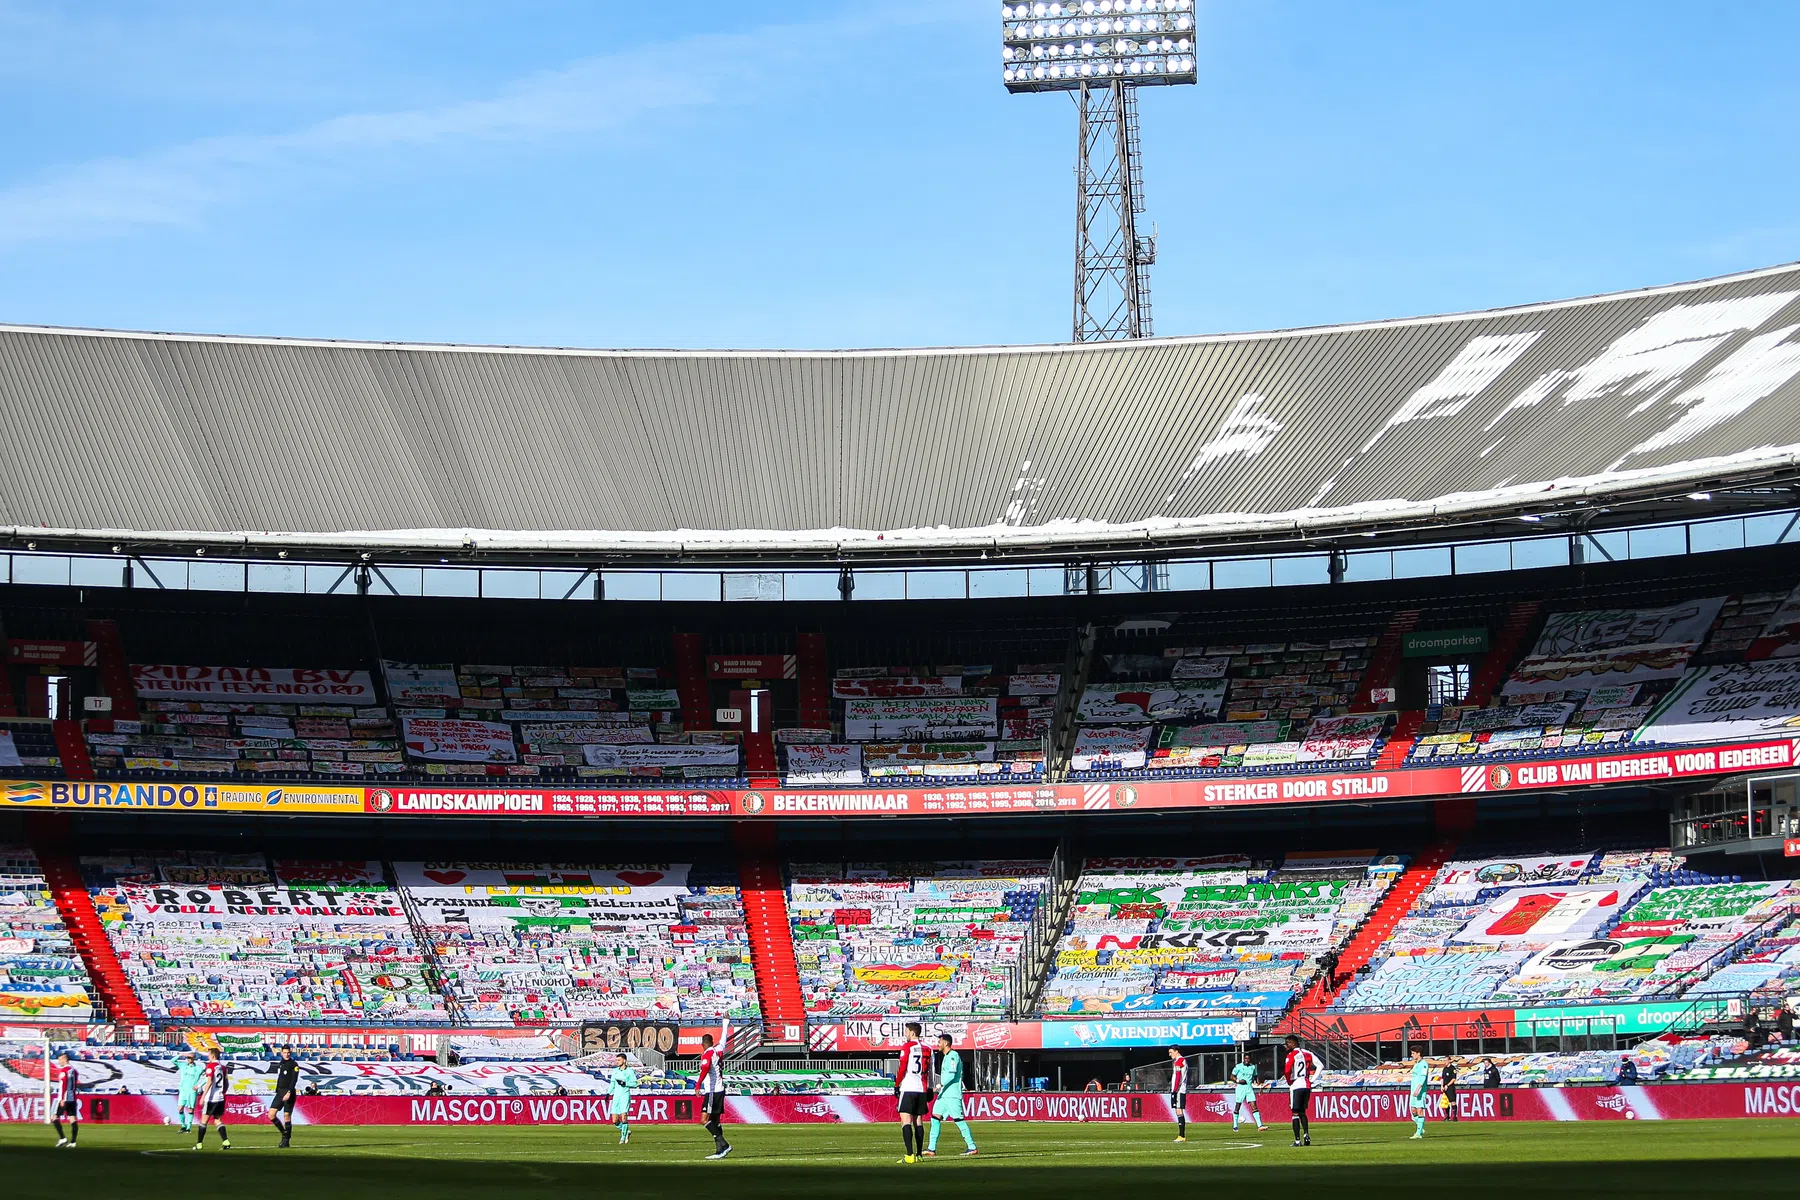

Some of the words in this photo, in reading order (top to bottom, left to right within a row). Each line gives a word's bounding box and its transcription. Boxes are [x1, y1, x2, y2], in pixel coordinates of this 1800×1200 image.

[1408, 635, 1482, 649] droomparken
[134, 679, 216, 692] STEUNT
[222, 682, 364, 696] FEYENOORD
[722, 711, 735, 719] UU
[1517, 766, 1558, 785] CLUB
[1561, 762, 1592, 782] VAN
[1596, 755, 1673, 779] IEDEREEN,
[1675, 752, 1716, 773] VOOR
[1719, 746, 1789, 769] IEDEREEN
[51, 783, 199, 806] BURANDO
[221, 791, 262, 803] TRADING
[1204, 783, 1278, 802] STERKER
[1282, 780, 1327, 798] DOOR
[1331, 776, 1388, 796] STRIJD
[284, 793, 360, 805] ENVIRONMENTAL
[398, 793, 543, 811] LANDSKAMPIOEN
[773, 794, 908, 811] BEKERWINNAAR
[1085, 858, 1177, 870] RICARDO
[152, 889, 345, 906] ROBERT
[227, 906, 292, 915] NEVER
[294, 907, 345, 916] WALK
[346, 907, 404, 917] ALONE
[1730, 1003, 1738, 1012] M
[1527, 1008, 1625, 1030] droomparken
[1637, 1003, 1727, 1026] droompark
[789, 1029, 796, 1038] U
[847, 1022, 873, 1037] KIM
[1094, 1022, 1233, 1041] VRIENDENLOTER
[1395, 1030, 1427, 1040] adidas
[1465, 1028, 1497, 1038] adidas
[411, 1099, 525, 1122] MASCOT®
[963, 1096, 1044, 1118] MASCOT®
[1047, 1097, 1128, 1119] WORKWEAR
[1315, 1094, 1390, 1118] MASCOT®
